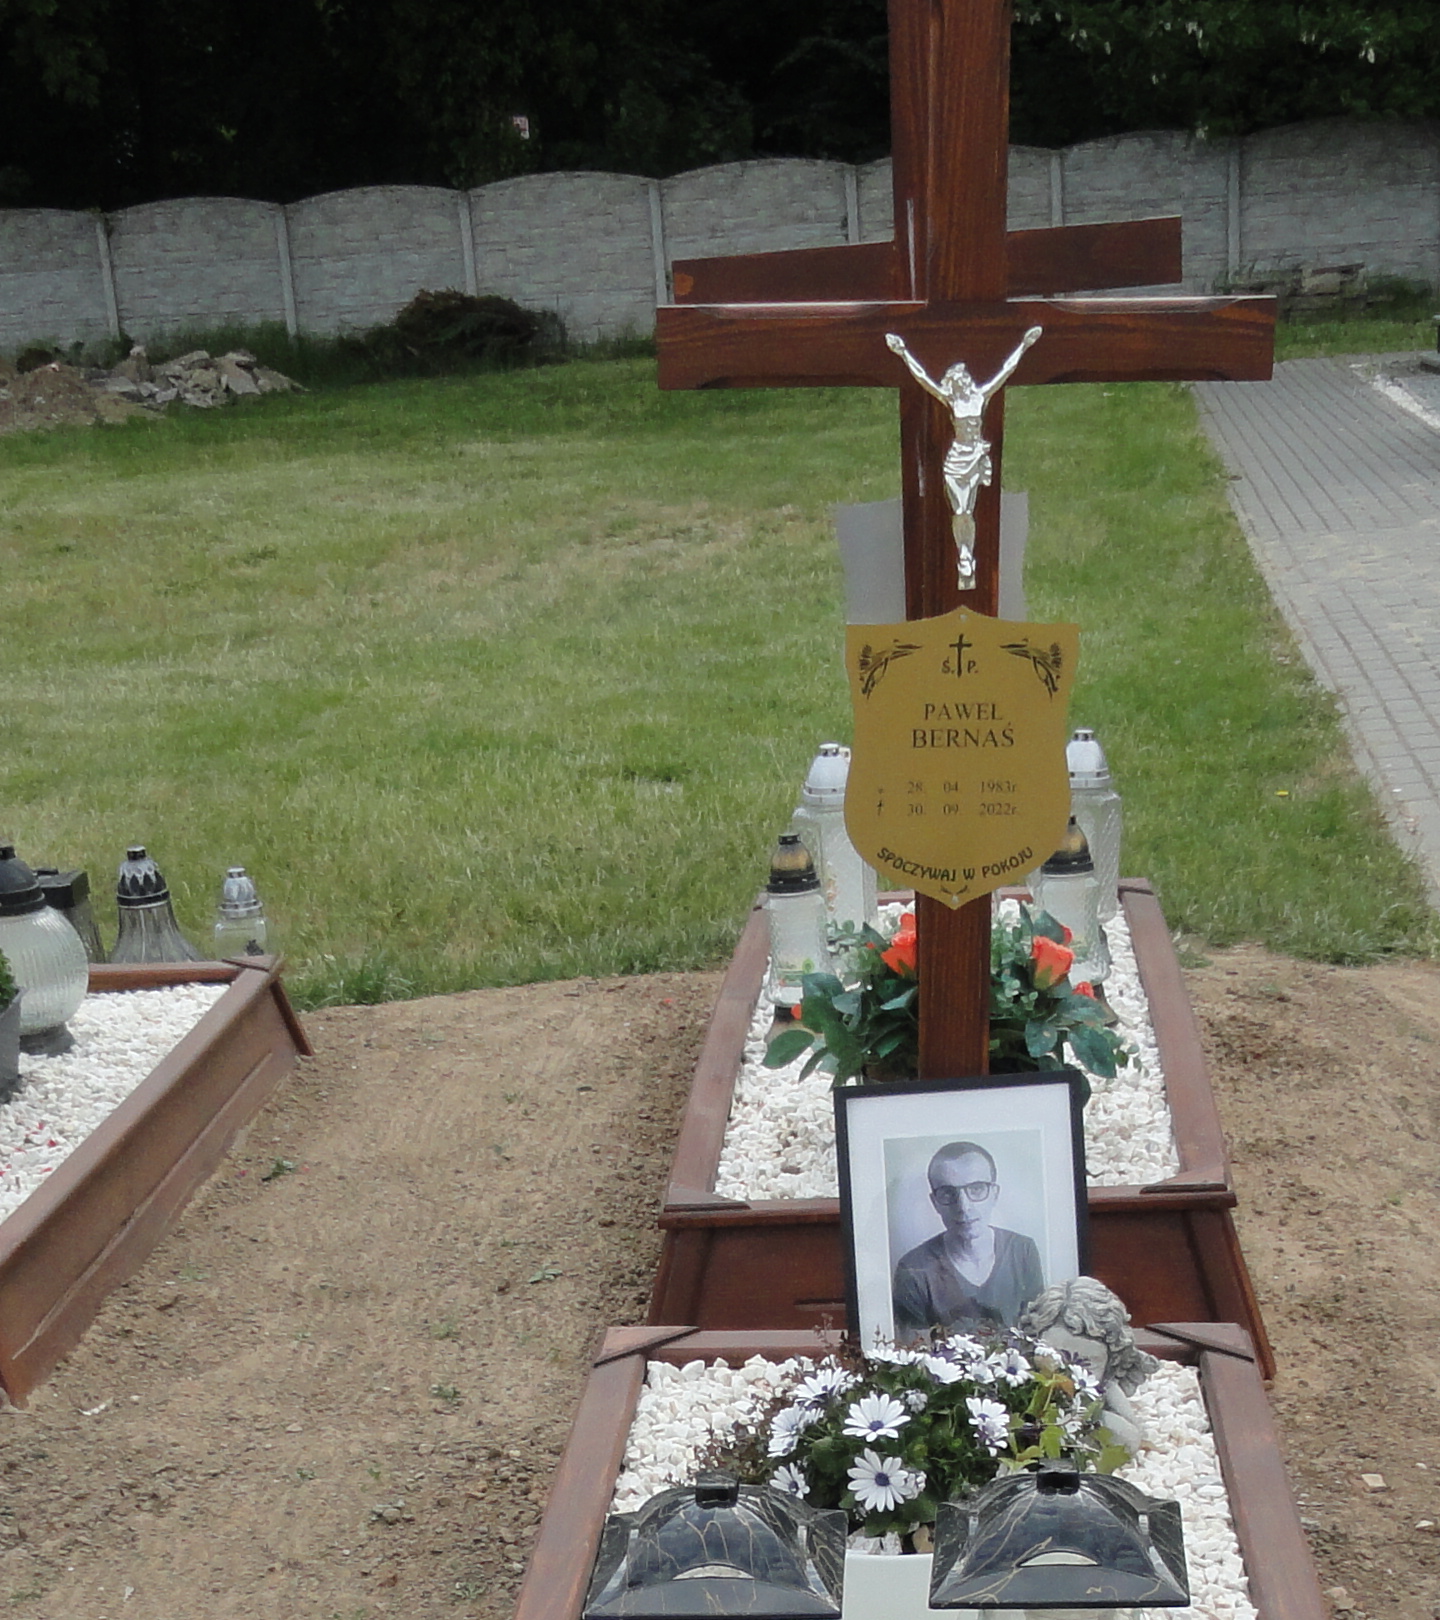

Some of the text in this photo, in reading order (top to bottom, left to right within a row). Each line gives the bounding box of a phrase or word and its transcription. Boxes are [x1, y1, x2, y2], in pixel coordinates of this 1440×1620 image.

[967, 659, 979, 674] P.
[912, 721, 1015, 749] BERNAŚ
[876, 846, 1034, 881] SPOCZYWAJ W POKOJU
